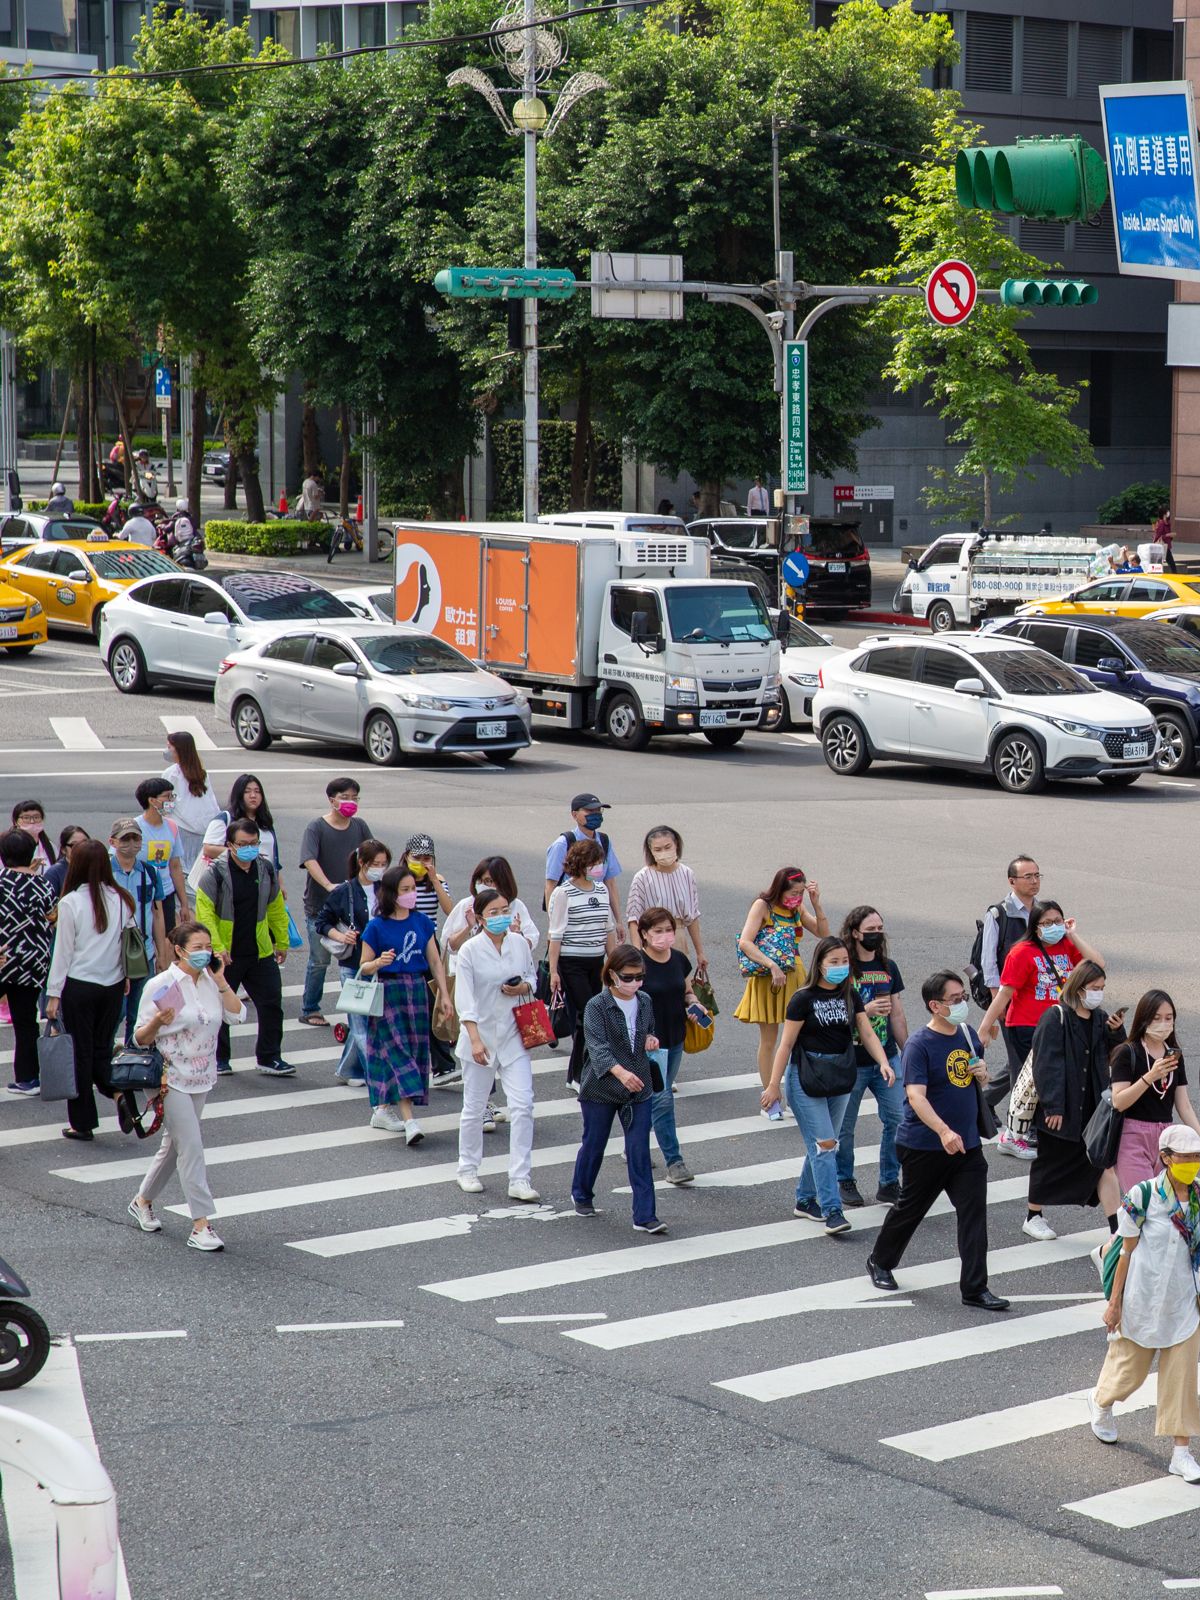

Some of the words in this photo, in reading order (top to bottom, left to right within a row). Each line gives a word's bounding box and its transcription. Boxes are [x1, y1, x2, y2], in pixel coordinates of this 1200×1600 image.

[1112, 135, 1192, 176] 內側車道專用
[1122, 212, 1140, 231] Inside
[1141, 212, 1160, 232] Lanes
[1160, 213, 1179, 238] Signal
[1179, 212, 1195, 239] Only
[156, 369, 163, 385] P
[791, 368, 801, 439] 忠孝東路四段
[972, 580, 1023, 591] 080-080-9000
[495, 597, 517, 606] LOUISA
[444, 606, 477, 626] 歐力士
[455, 628, 477, 647] 租賃
